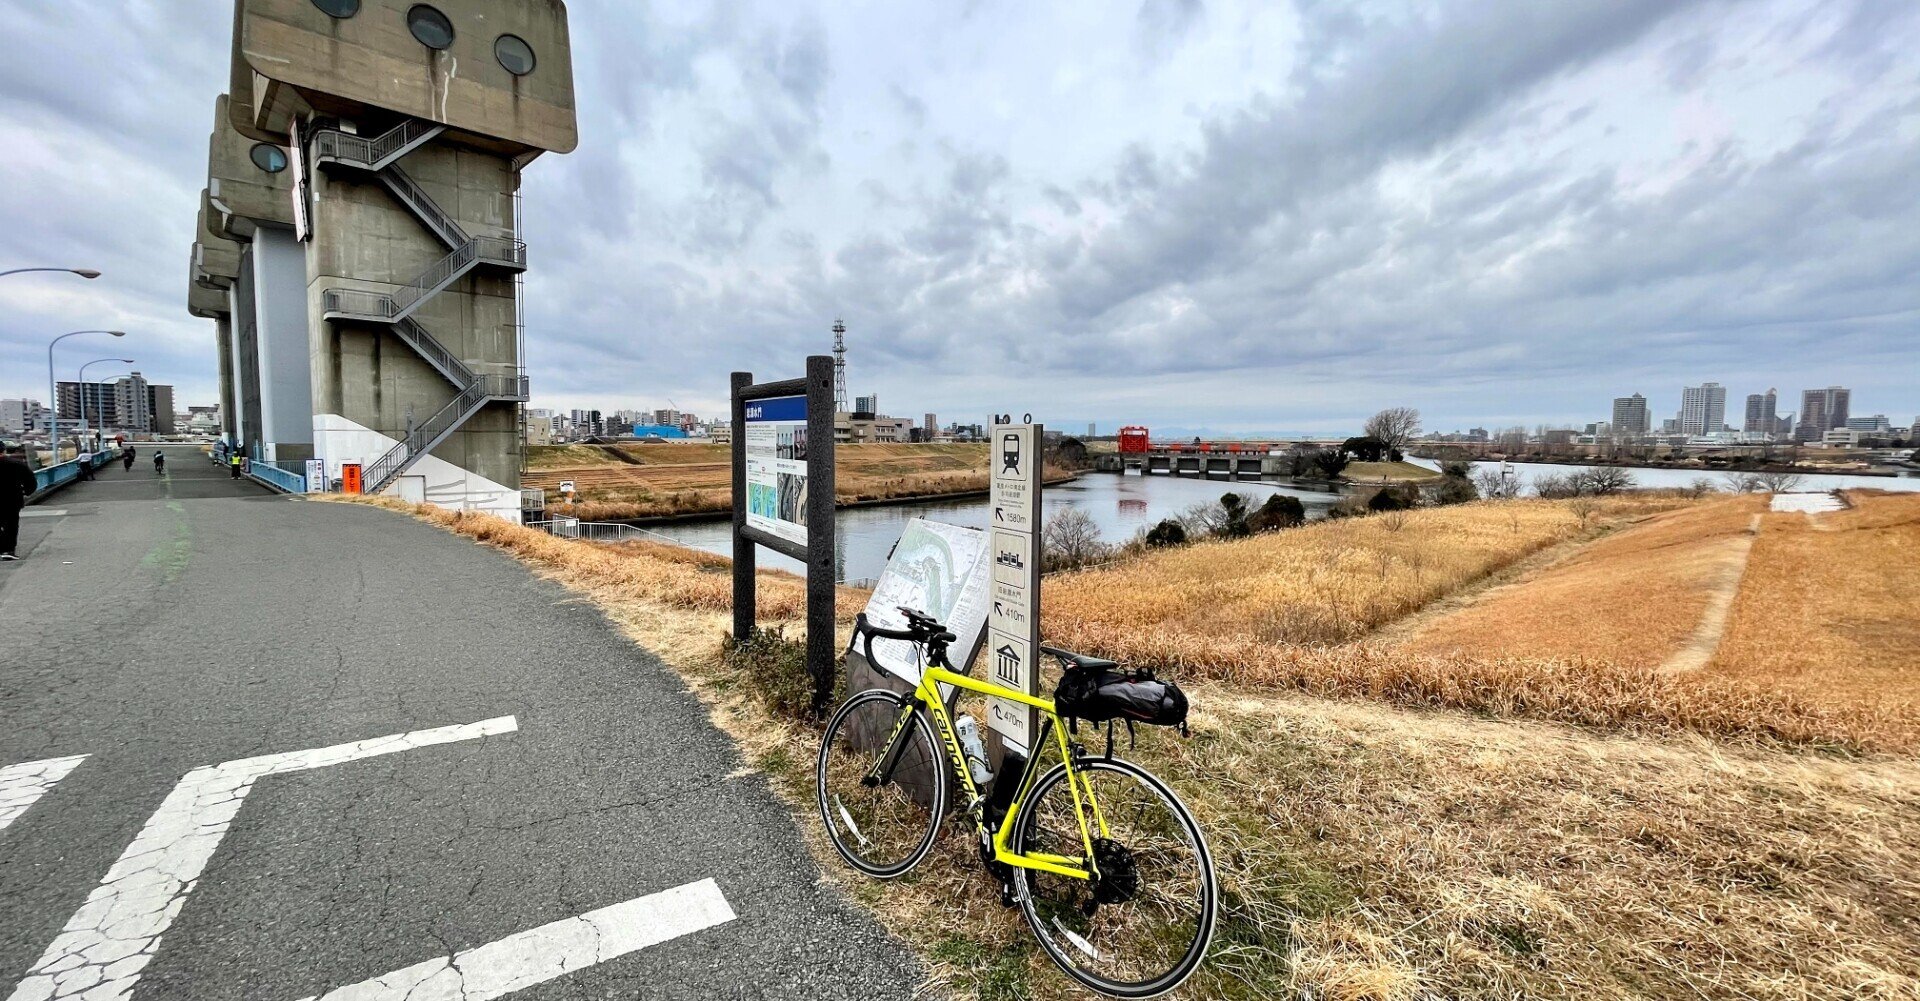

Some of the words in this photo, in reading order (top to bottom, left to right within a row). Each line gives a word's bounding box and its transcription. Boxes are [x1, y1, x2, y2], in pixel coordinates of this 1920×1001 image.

[1006, 512, 1027, 524] 1580m
[1005, 607, 1025, 624] 410m
[1003, 711, 1024, 730] 470m
